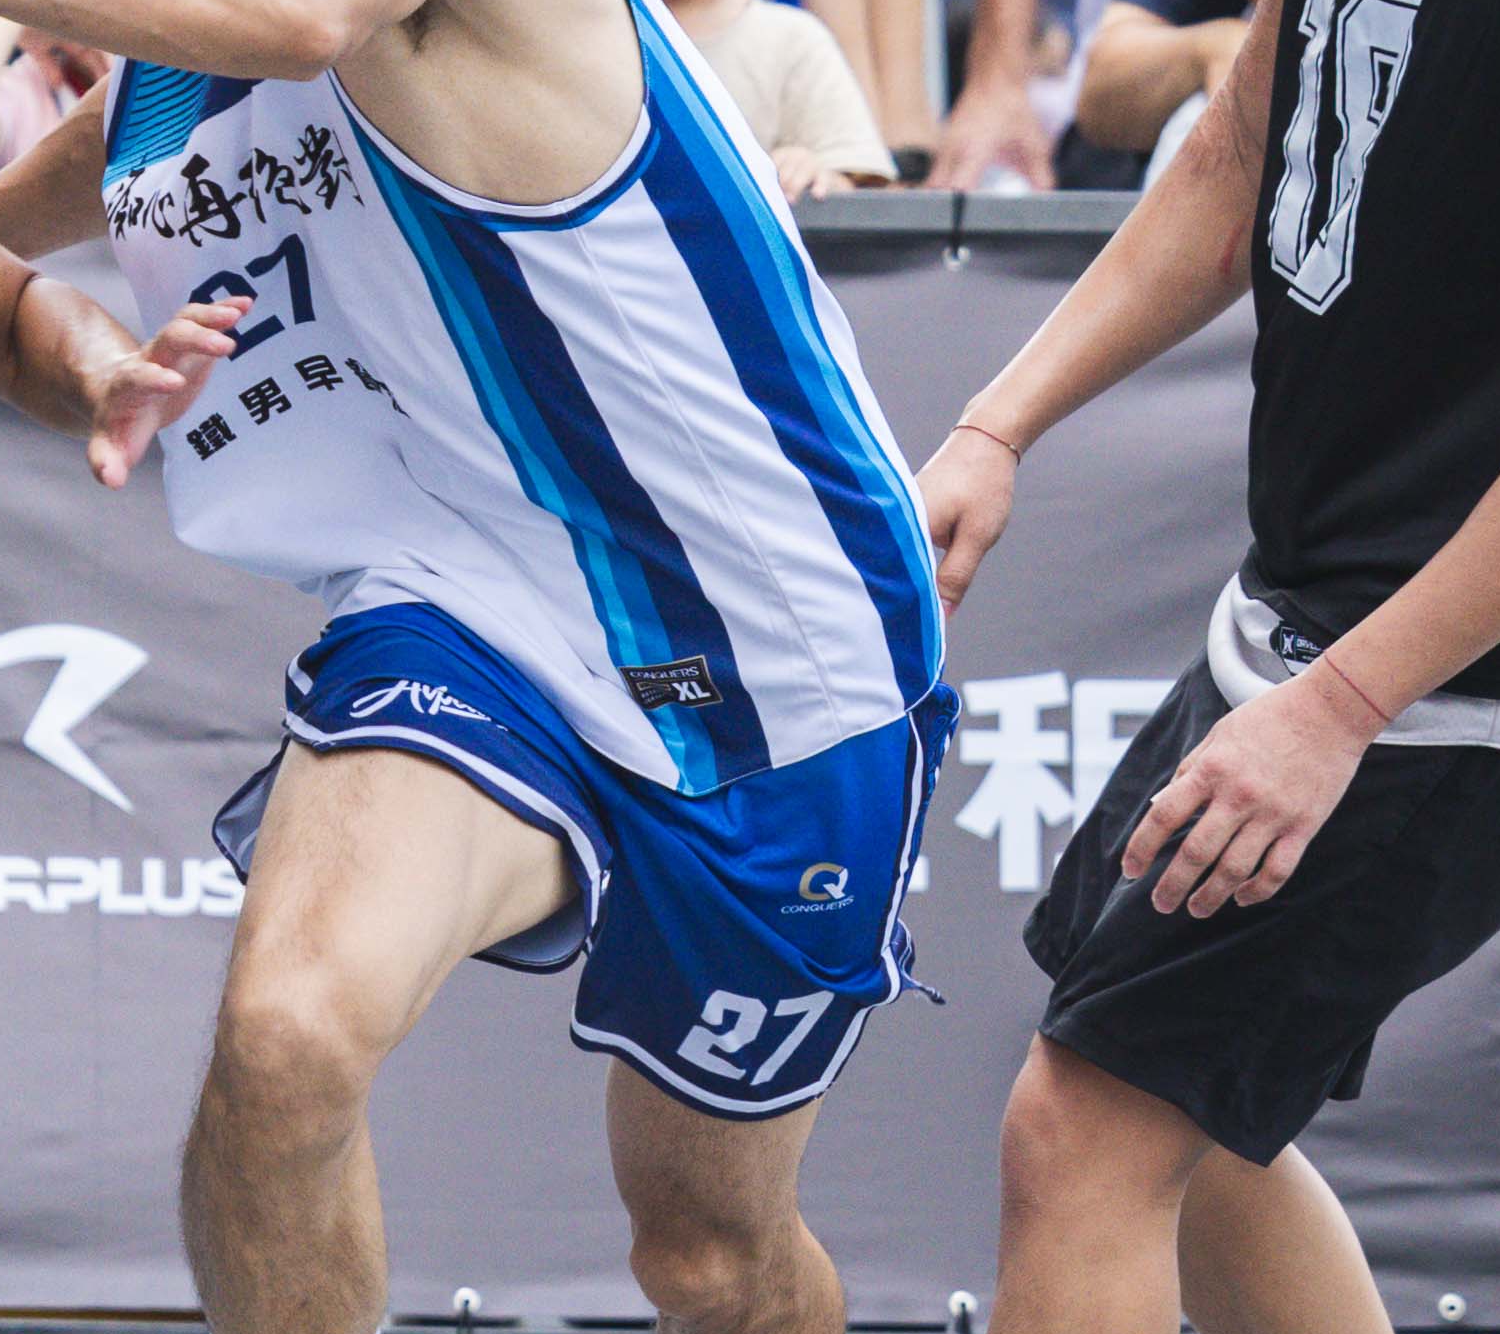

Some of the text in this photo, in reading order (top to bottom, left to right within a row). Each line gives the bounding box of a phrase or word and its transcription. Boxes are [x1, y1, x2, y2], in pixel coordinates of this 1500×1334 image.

[188, 233, 316, 362] 27
[671, 681, 712, 702] XL
[780, 895, 855, 915] CONQUERS
[675, 989, 835, 1086] 27
